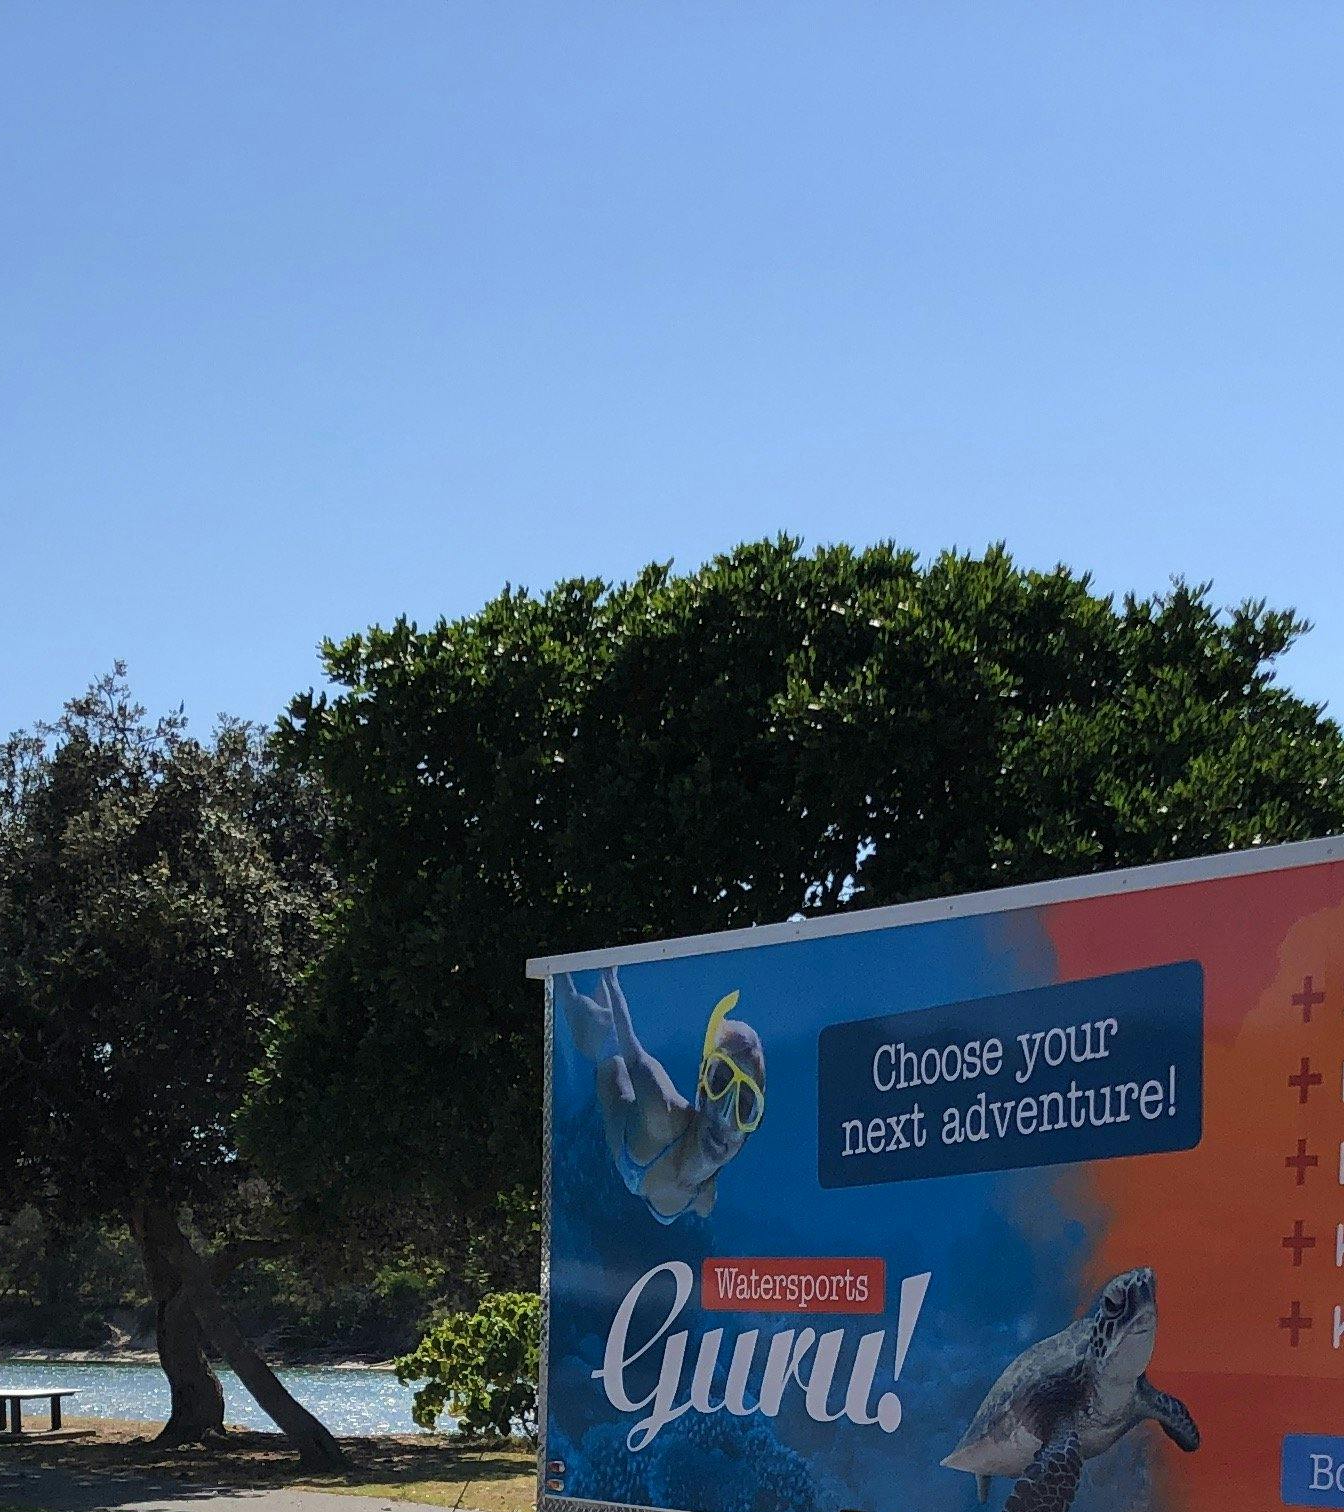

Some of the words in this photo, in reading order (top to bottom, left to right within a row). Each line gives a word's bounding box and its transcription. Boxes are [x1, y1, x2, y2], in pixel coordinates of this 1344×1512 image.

[872, 1036, 1003, 1091] Choose
[1014, 1017, 1119, 1084] your
[842, 1105, 926, 1157] next
[941, 1066, 1177, 1145] adventure!
[713, 1266, 870, 1309] Watersports
[591, 1260, 933, 1453] Guru!
